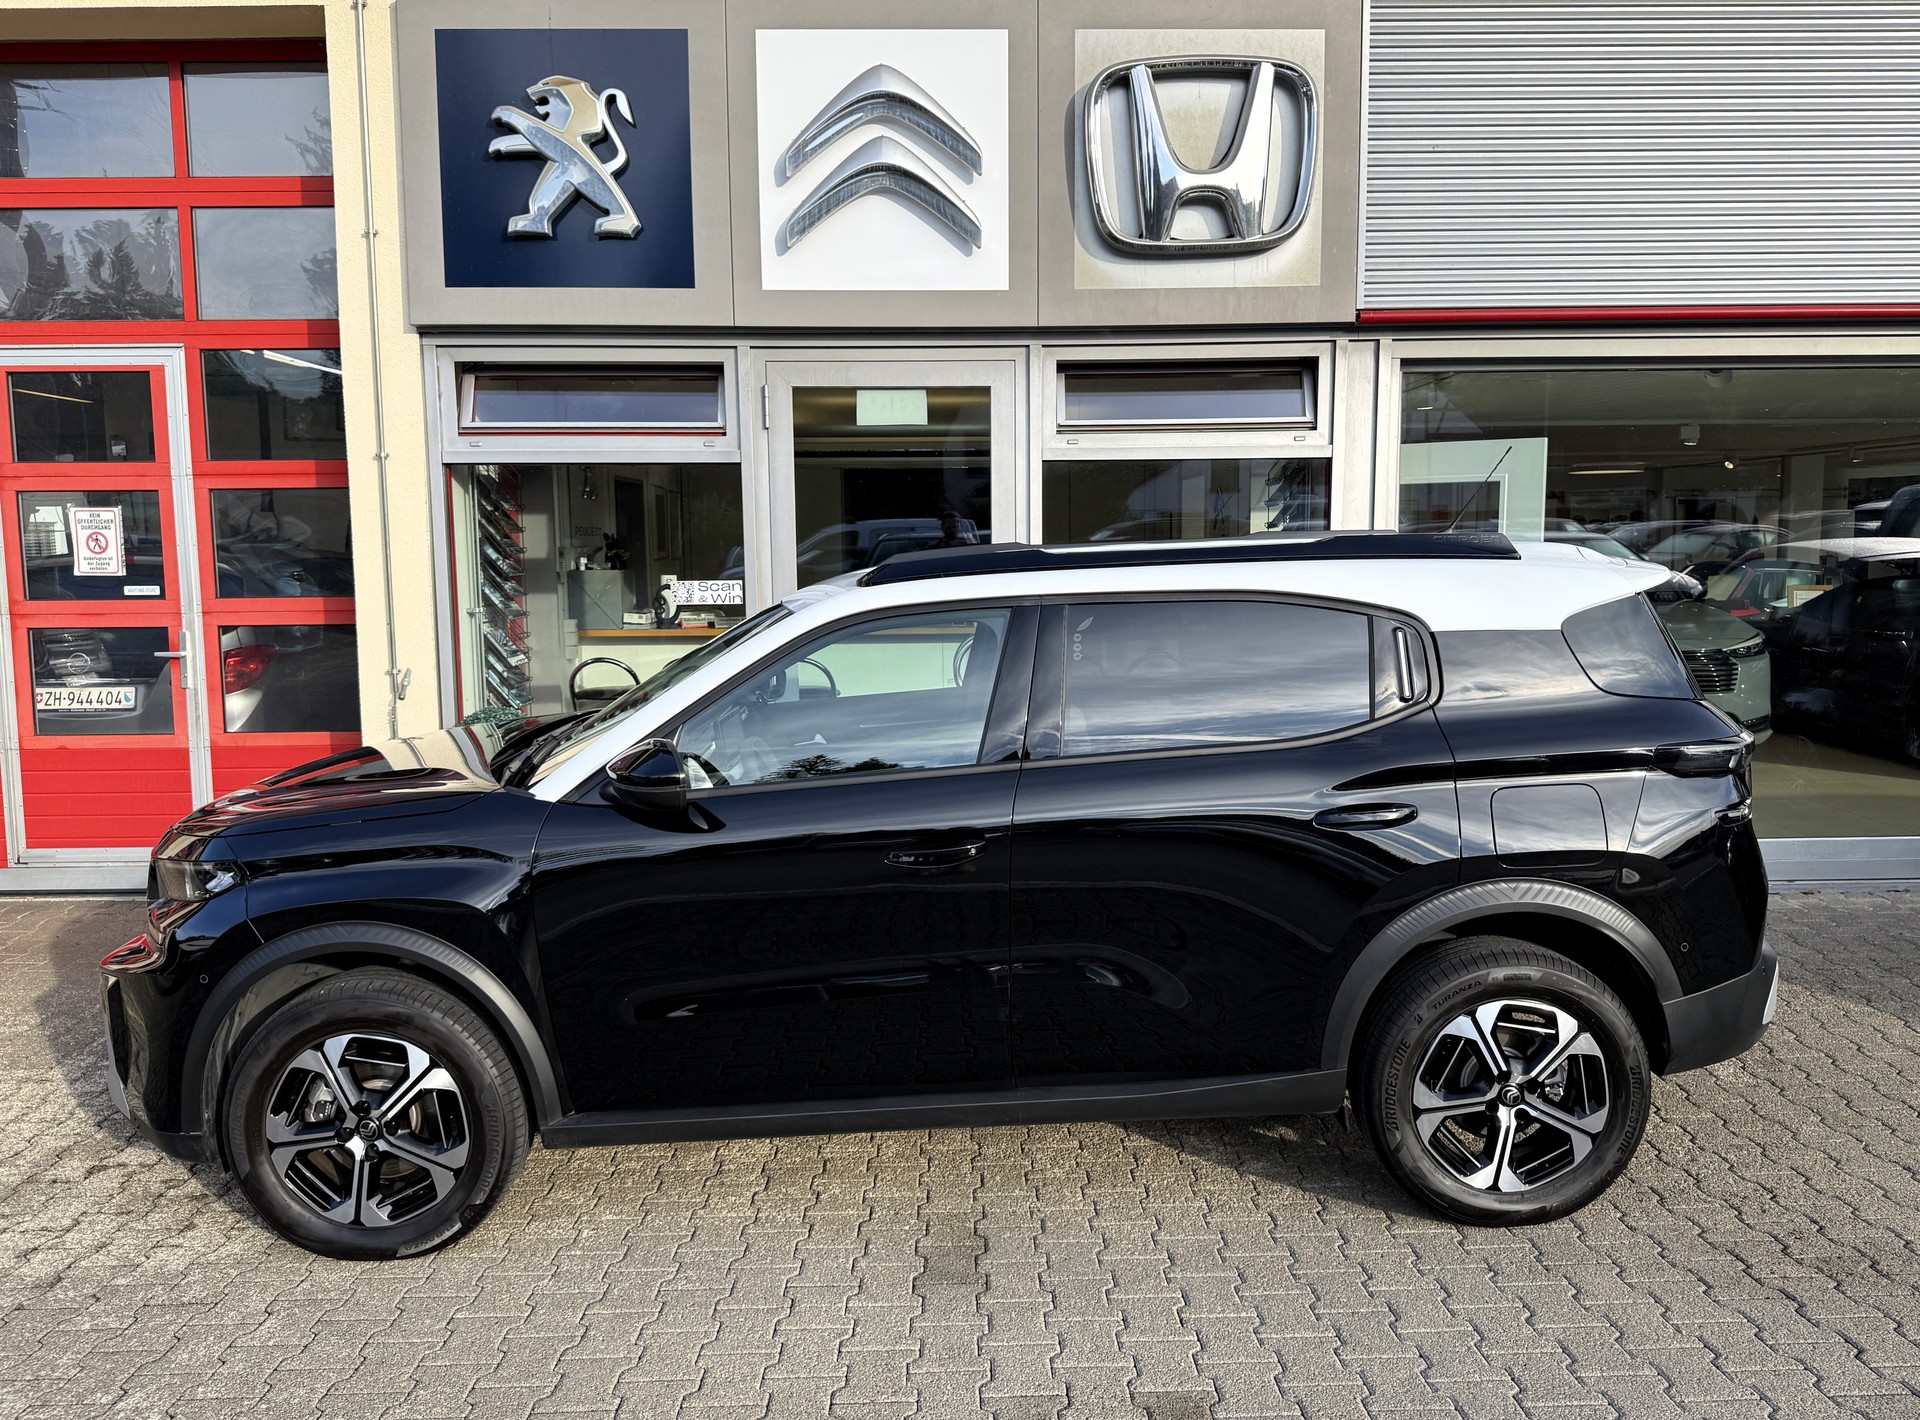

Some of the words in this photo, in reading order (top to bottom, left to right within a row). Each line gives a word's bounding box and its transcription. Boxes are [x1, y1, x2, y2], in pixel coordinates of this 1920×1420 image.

[698, 581, 742, 592] Scan
[698, 595, 709, 603] &
[711, 592, 743, 604] Win
[1431, 980, 1482, 1010] TURANZA
[1384, 1038, 1411, 1132] BRIDGESTONE
